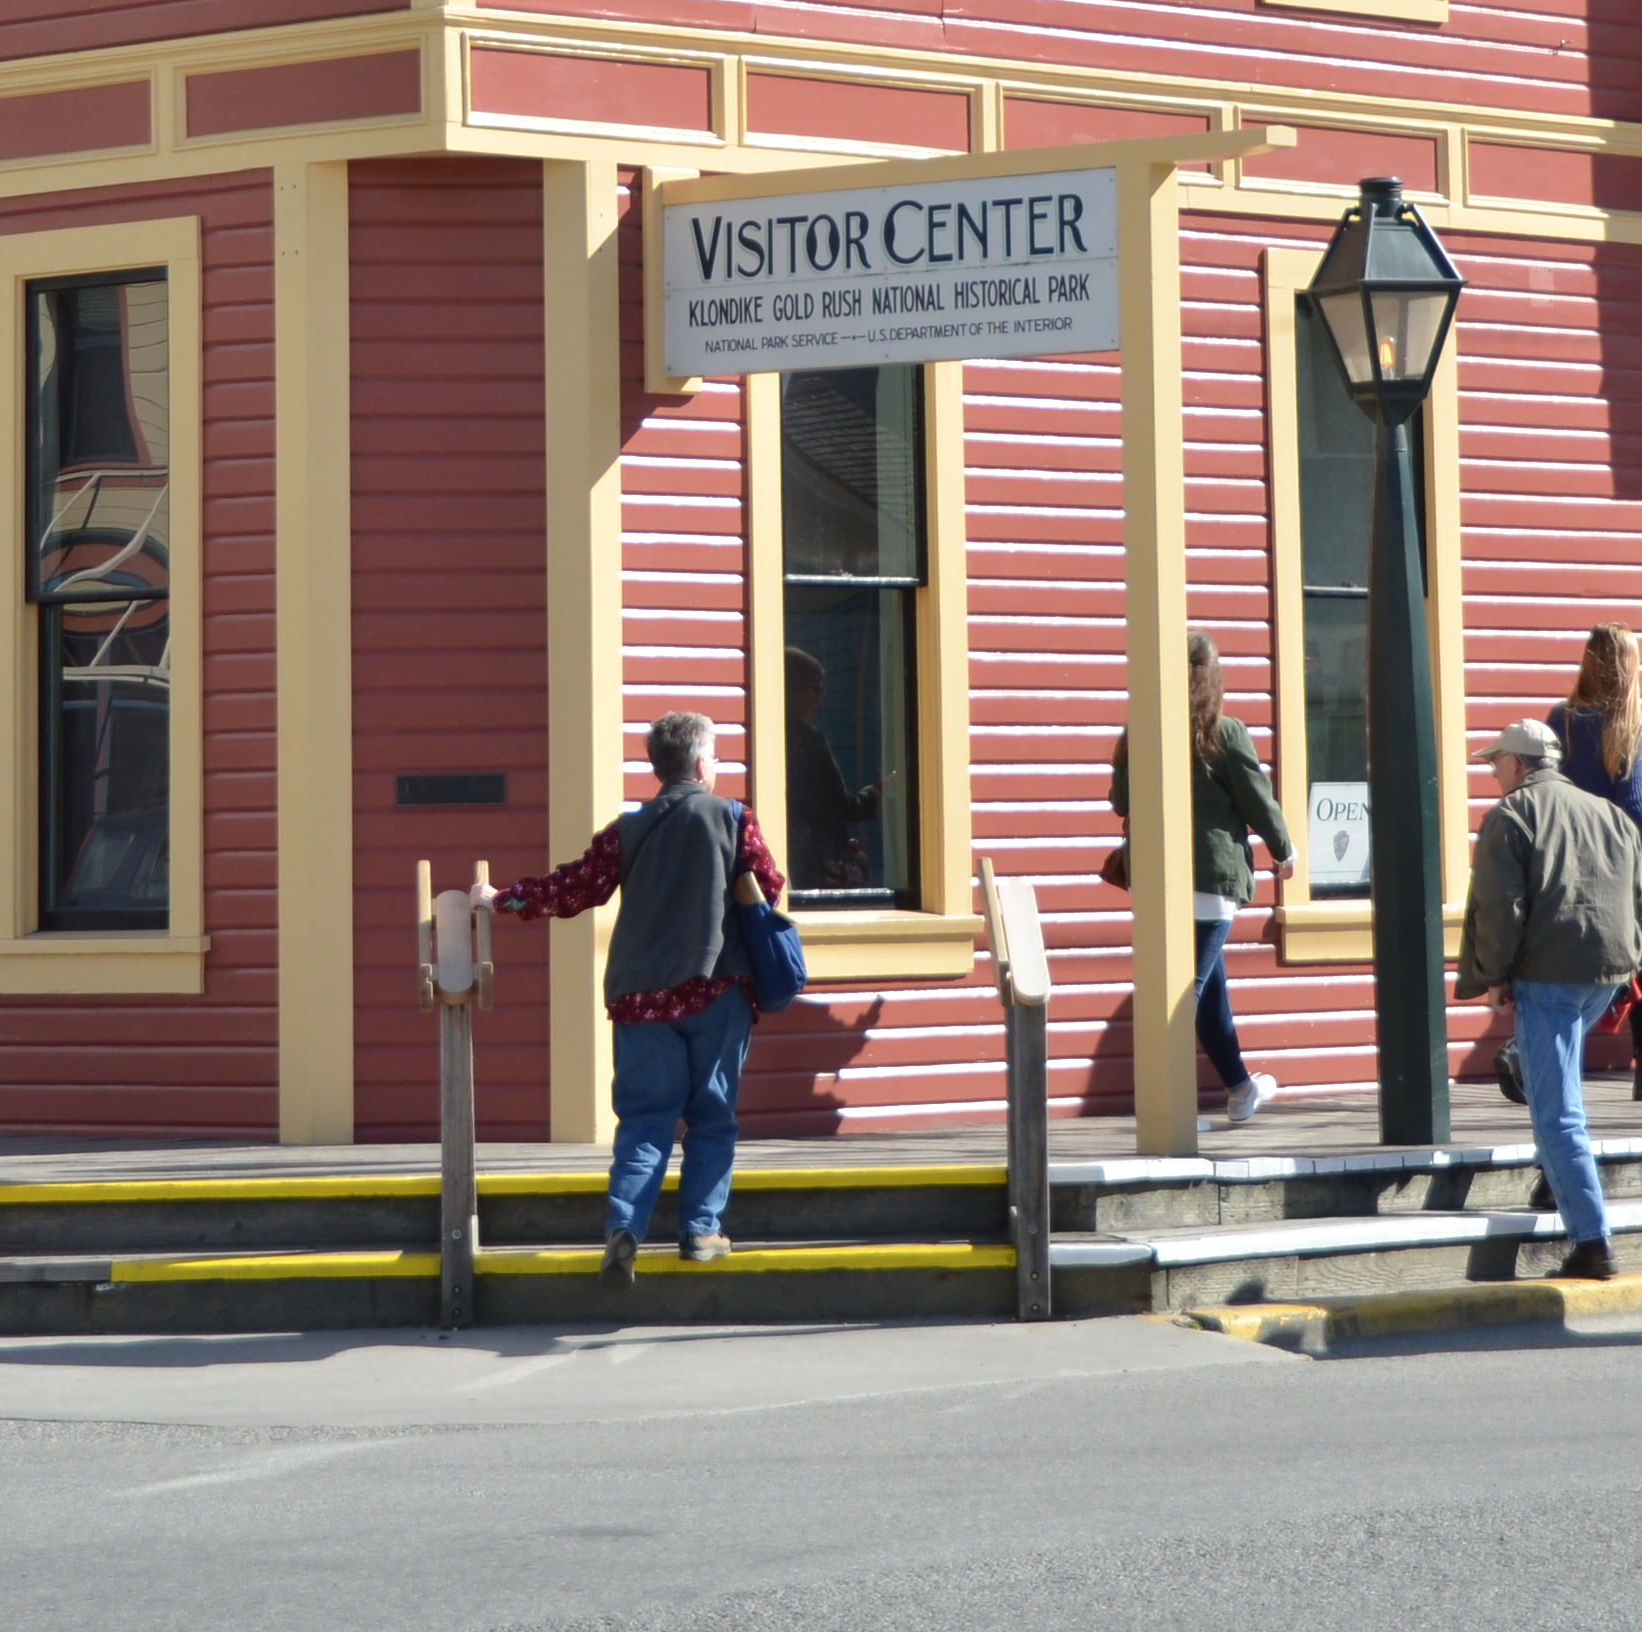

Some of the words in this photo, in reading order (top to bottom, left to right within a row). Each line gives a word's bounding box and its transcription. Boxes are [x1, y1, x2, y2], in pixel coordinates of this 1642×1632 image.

[690, 210, 872, 281] VISITOR
[883, 193, 1088, 265] CENTER
[689, 295, 764, 328] KLONDIKE
[773, 292, 814, 322] GOLD
[822, 288, 862, 318] RUSH
[872, 283, 945, 315] NATIONAL
[954, 276, 1041, 309] HISTORICAL
[1048, 273, 1090, 302] PARK
[705, 338, 758, 353] NATIONAL
[761, 335, 789, 349] PARK
[791, 332, 839, 347] SERVICE
[969, 322, 984, 335] OF
[986, 321, 1009, 335] THE
[1014, 316, 1073, 332] INTERIOR
[1316, 797, 1370, 822] OPEN
